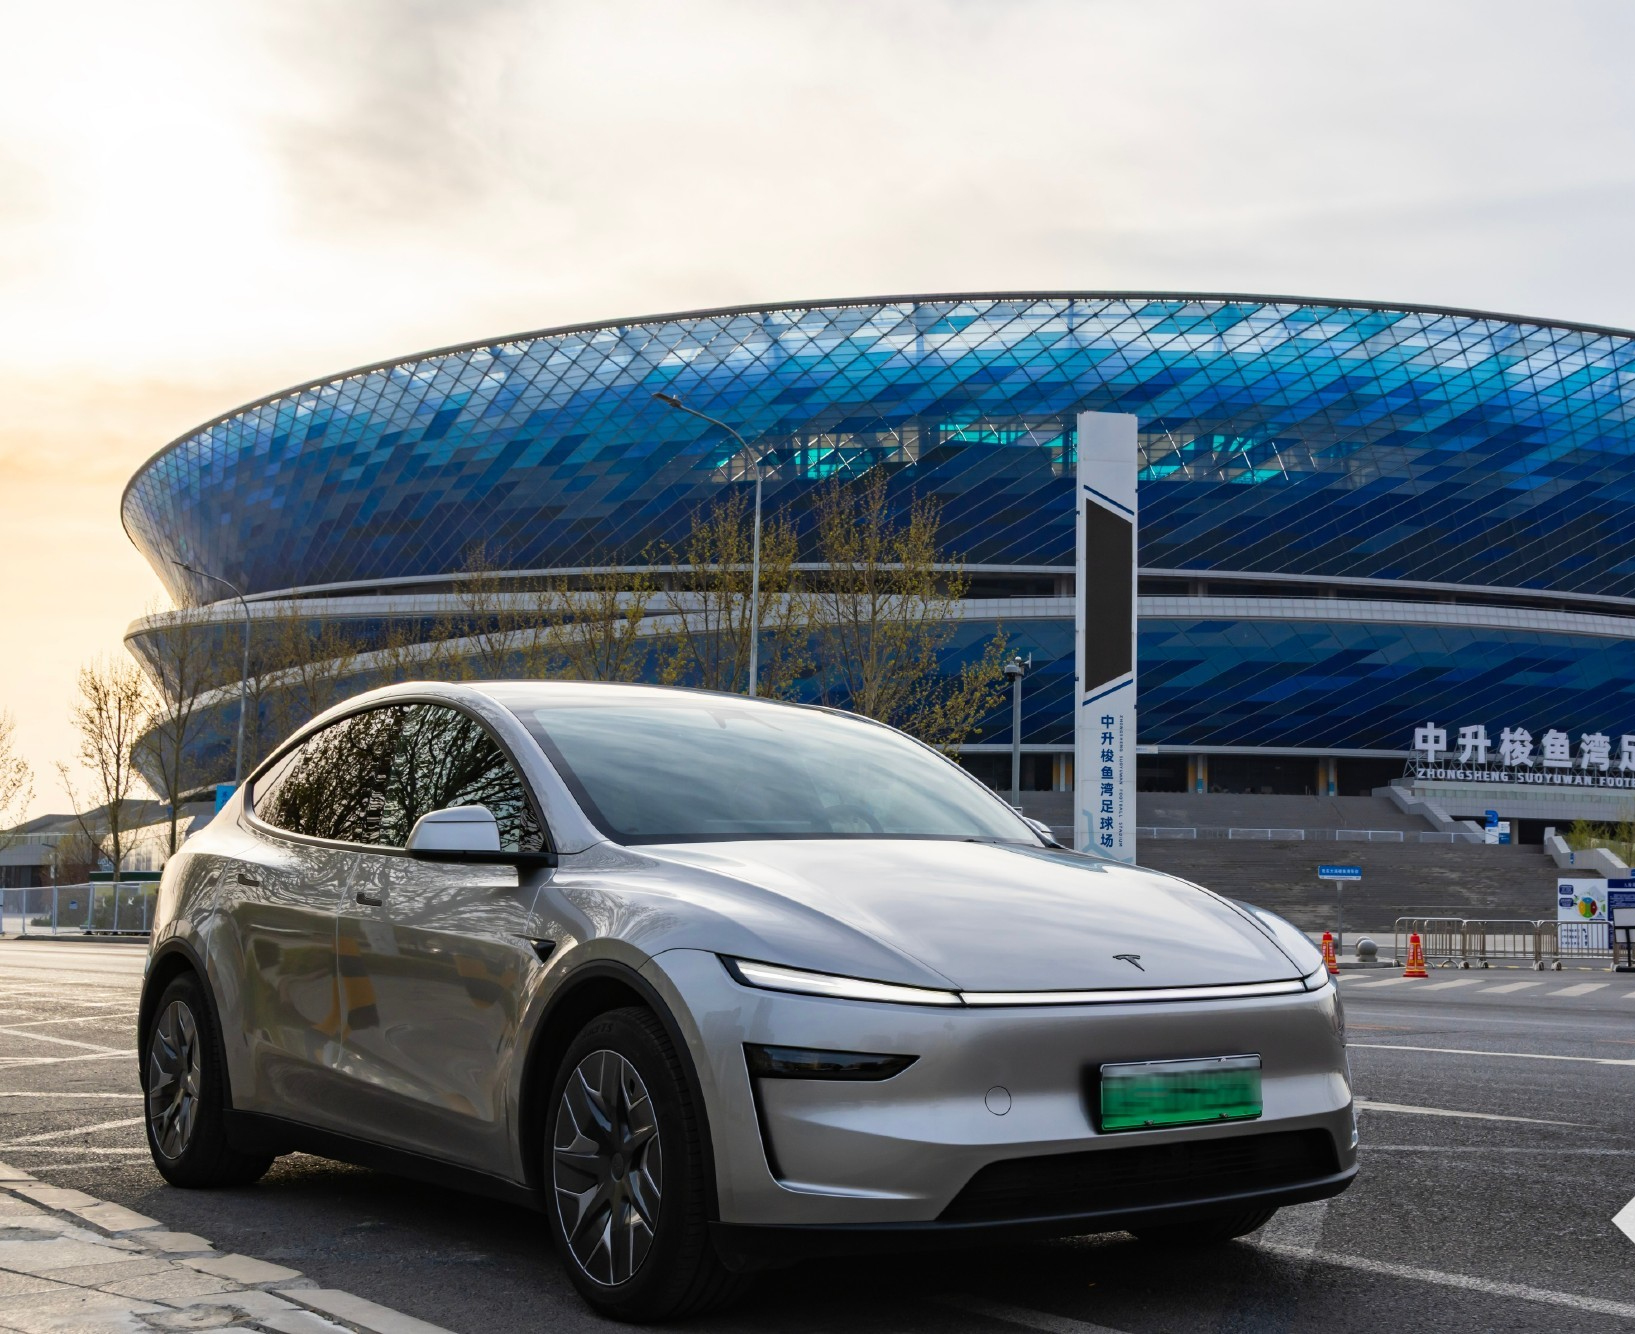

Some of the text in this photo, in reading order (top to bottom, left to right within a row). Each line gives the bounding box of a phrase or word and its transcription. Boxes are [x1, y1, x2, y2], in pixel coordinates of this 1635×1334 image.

[1100, 714, 1115, 848] 中升梭鱼湾足球场
[1417, 768, 1509, 782] ZHONGSHENG
[1517, 772, 1592, 786] SUOYUWAN
